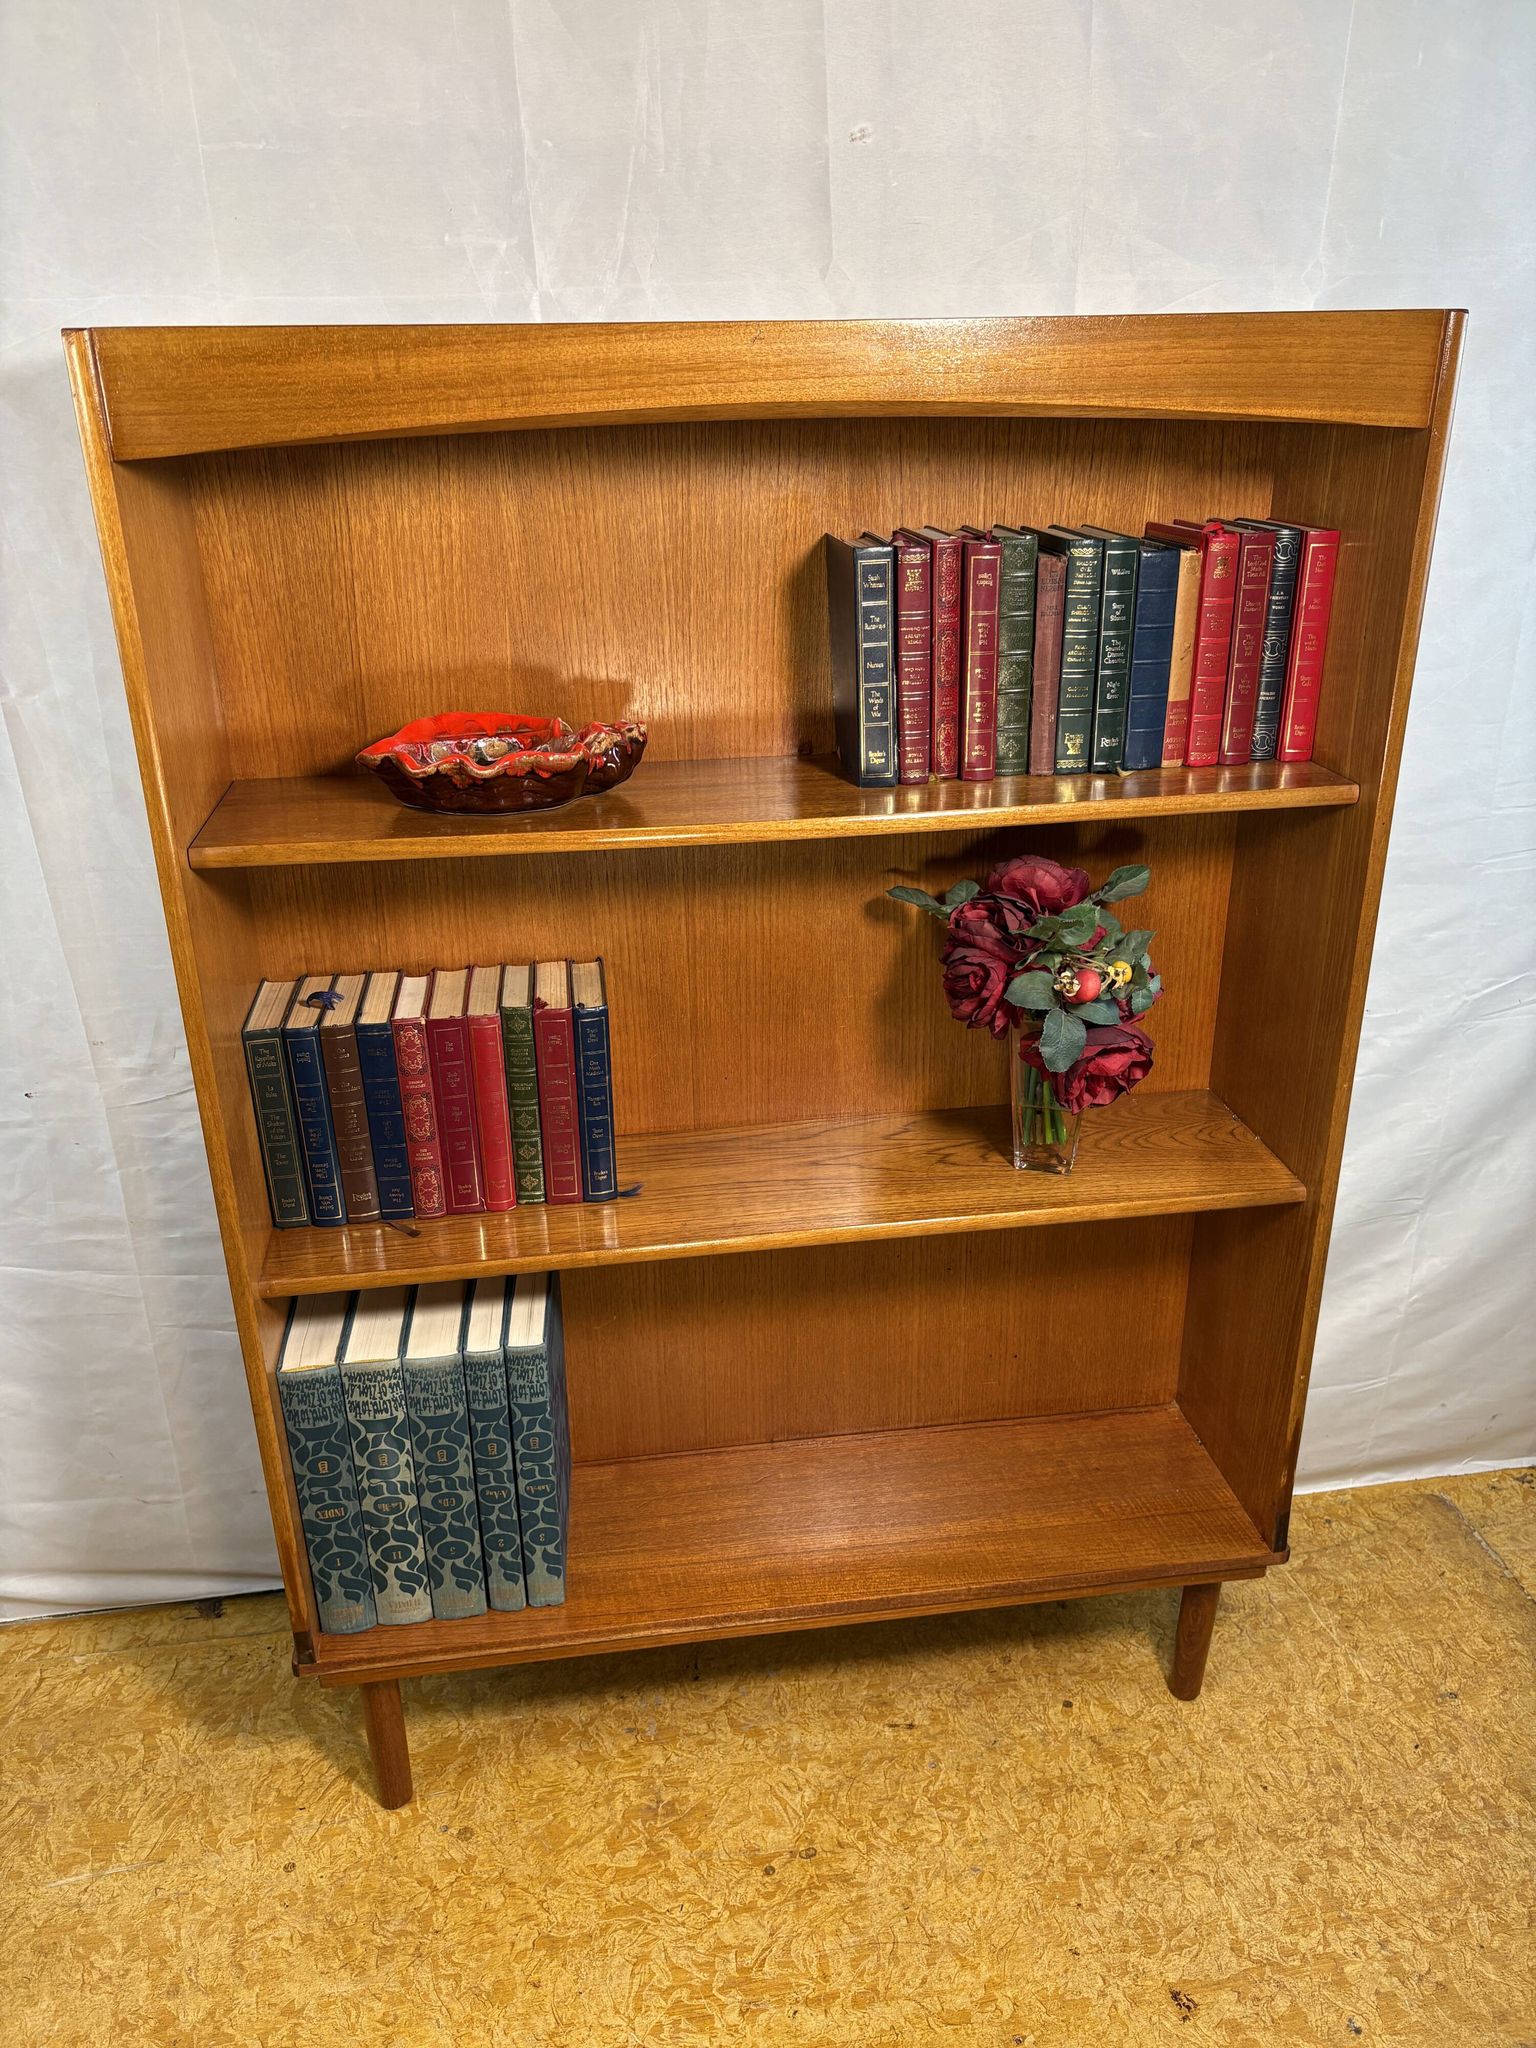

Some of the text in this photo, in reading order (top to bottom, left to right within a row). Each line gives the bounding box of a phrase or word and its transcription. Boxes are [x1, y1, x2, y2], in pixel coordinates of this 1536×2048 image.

[870, 757, 885, 765] Digest
[316, 1506, 346, 1521] INDEX
[538, 1532, 546, 1542] 3
[496, 1538, 505, 1548] 2
[391, 1550, 403, 1561] 11
